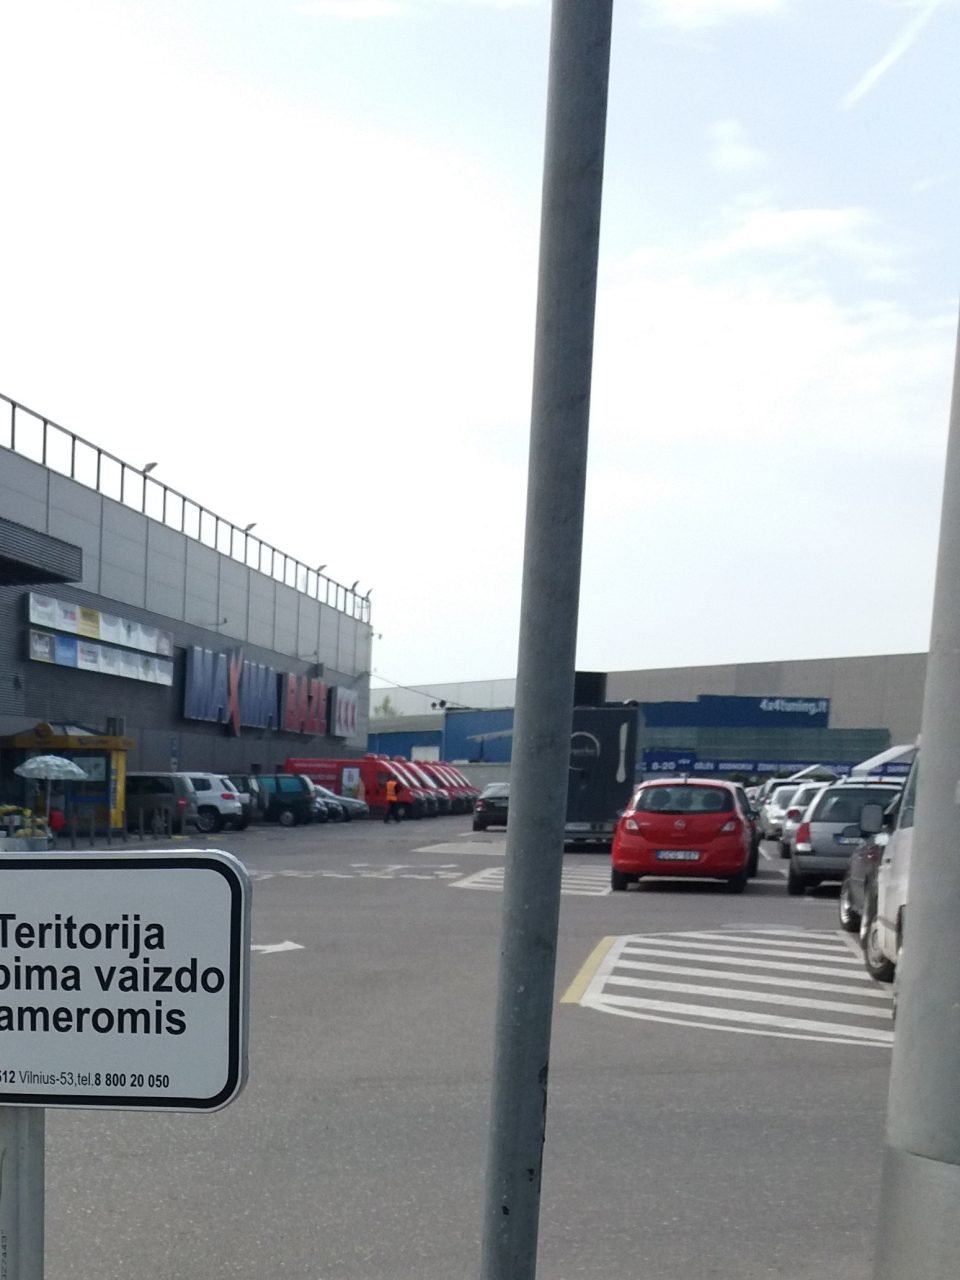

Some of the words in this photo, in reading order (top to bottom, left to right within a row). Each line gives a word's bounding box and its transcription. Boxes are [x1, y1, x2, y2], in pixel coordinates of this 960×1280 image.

[186, 645, 278, 737] MAXIMA
[94, 957, 225, 993] vaizdo
[105, 1073, 127, 1087] 800
[130, 1073, 144, 1088] 20
[147, 1074, 170, 1089] 050
